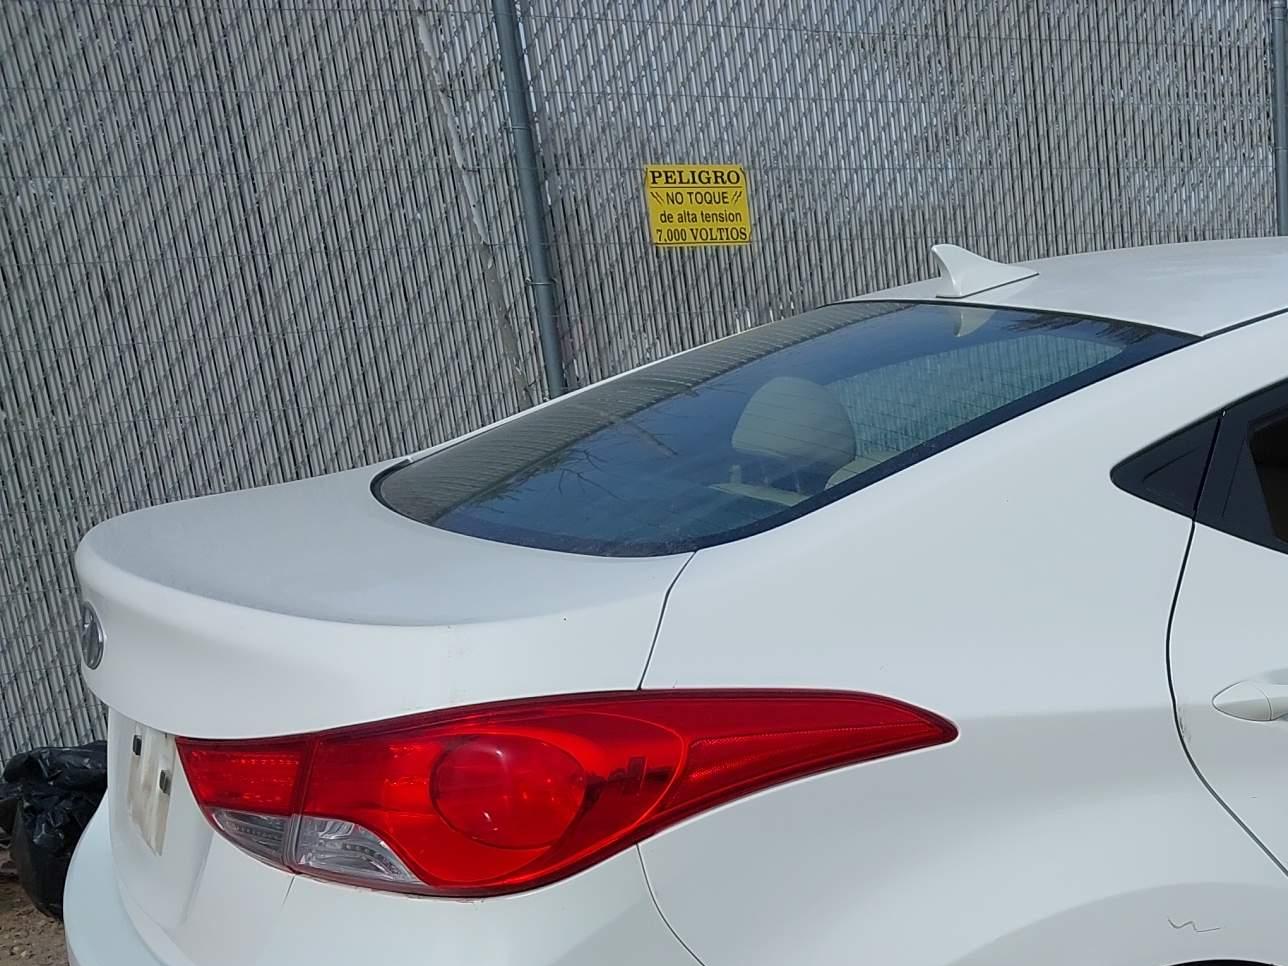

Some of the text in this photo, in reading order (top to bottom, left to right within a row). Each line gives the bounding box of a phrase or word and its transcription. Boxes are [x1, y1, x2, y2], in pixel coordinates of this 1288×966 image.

[650, 170, 740, 185] PELIGRO
[666, 191, 729, 205] NO TOQUE
[660, 209, 742, 224] de alta tension
[690, 226, 748, 240] VOLTIOS
